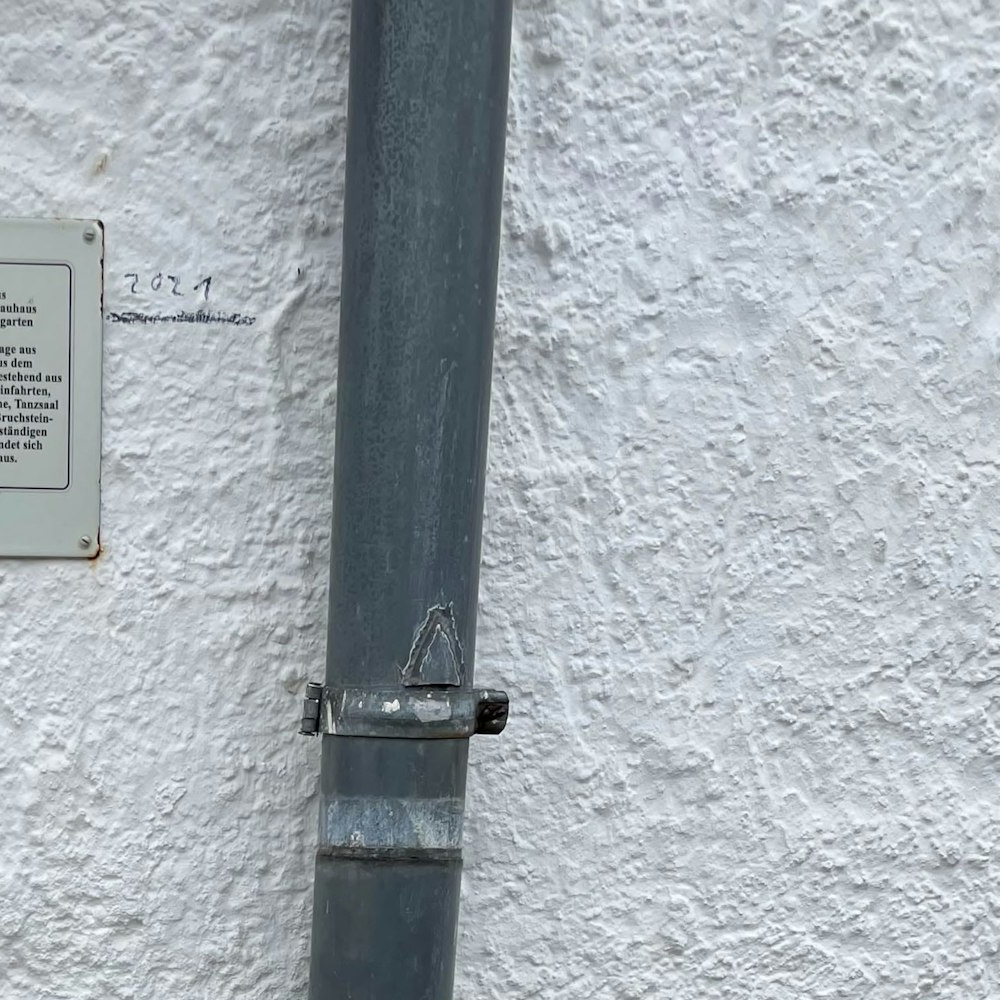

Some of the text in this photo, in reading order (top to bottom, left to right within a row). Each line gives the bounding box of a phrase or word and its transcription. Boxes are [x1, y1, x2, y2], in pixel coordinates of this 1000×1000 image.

[124, 272, 212, 301] 2021
[19, 347, 37, 355] aus
[11, 358, 33, 368] dem
[45, 374, 62, 383] aus
[14, 399, 59, 410] Tanzsaal
[23, 439, 43, 450] sich
